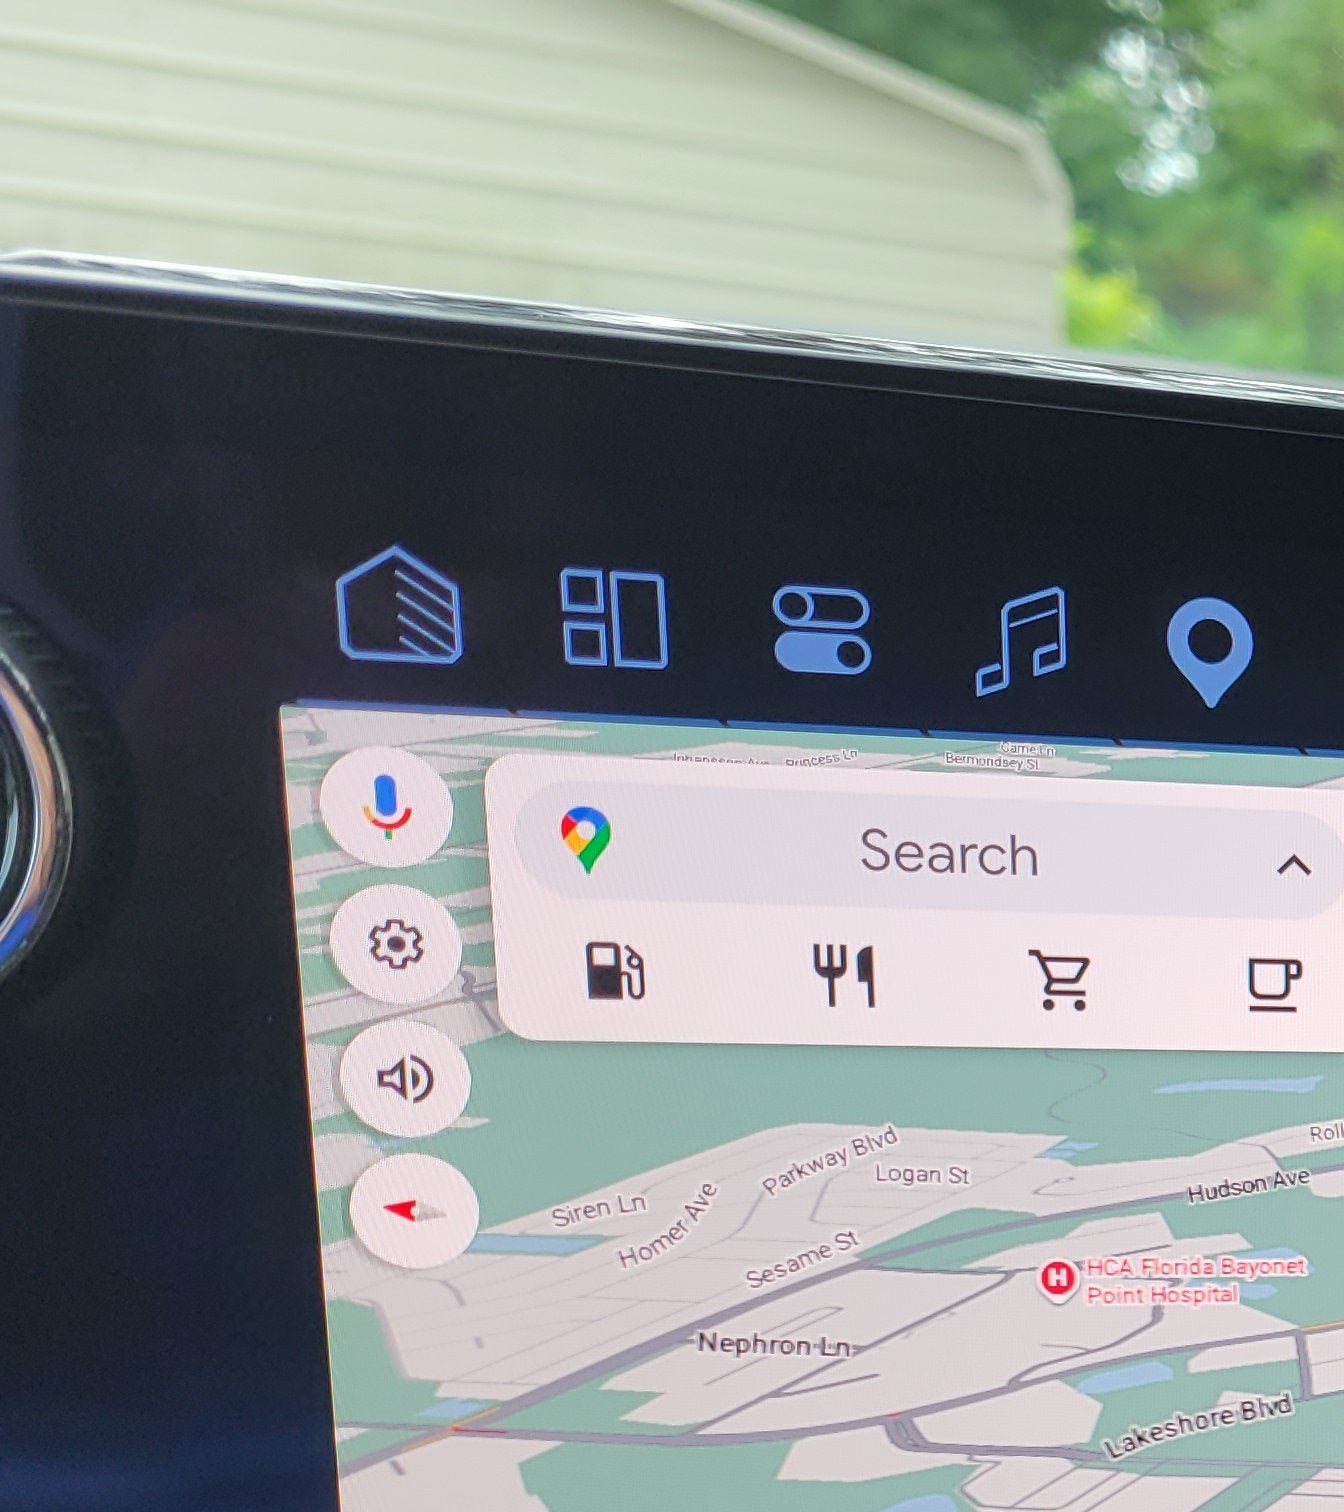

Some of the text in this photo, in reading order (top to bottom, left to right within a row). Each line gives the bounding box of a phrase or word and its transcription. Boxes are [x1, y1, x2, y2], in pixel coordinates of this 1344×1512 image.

[861, 828, 1038, 877] Search
[763, 1125, 898, 1195] Parkway Blvd
[876, 1164, 970, 1185] Logan St
[1188, 1169, 1310, 1203] Hudson Ave
[552, 1194, 646, 1227] Siren Ln
[618, 1182, 718, 1269] Homer Ave
[746, 1231, 859, 1288] Sesame St
[1088, 1257, 1306, 1277] HCA Florida Bayonet
[1088, 1286, 1238, 1304] Point Hospital
[699, 1333, 850, 1357] Nephron Ln
[1105, 1393, 1294, 1459] Lakeshore Blvd
